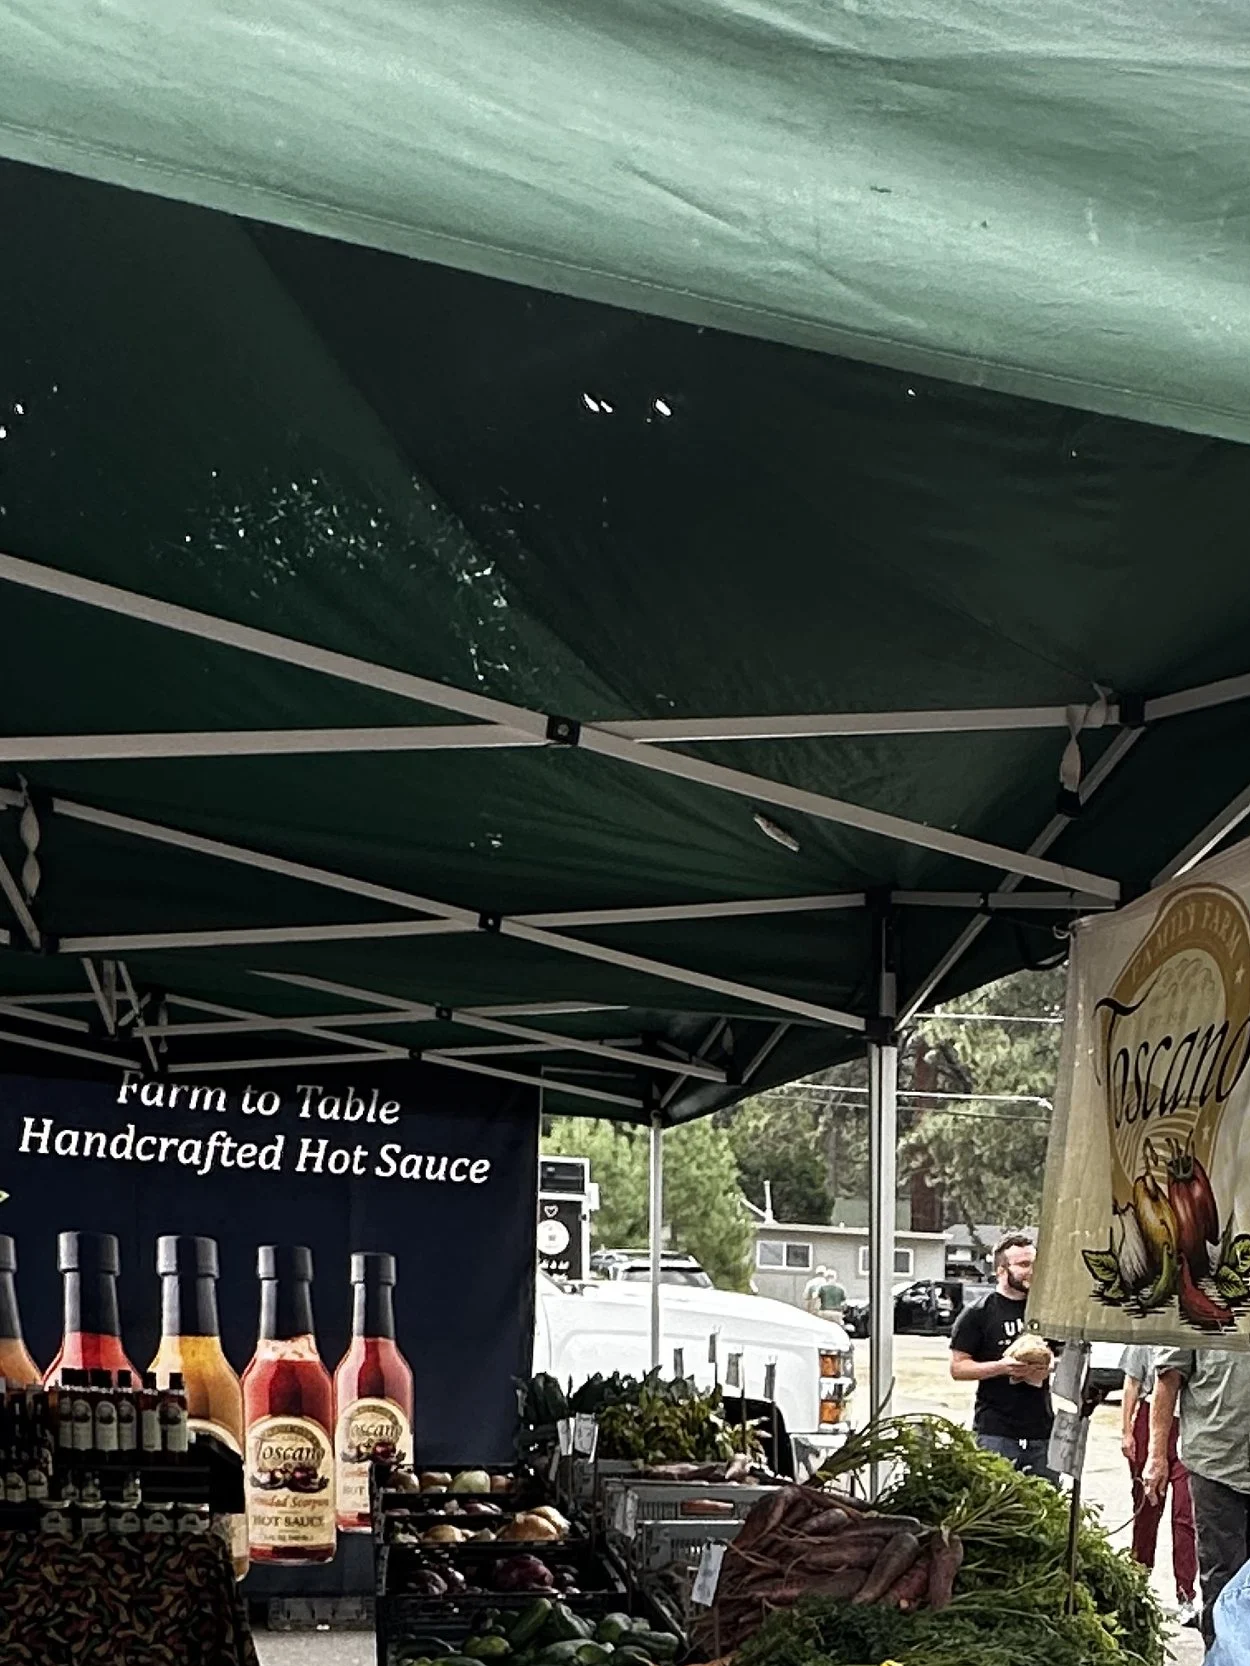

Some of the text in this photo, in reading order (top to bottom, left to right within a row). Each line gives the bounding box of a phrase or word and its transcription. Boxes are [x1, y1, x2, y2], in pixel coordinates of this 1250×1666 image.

[1200, 901, 1243, 958] FARM
[117, 1070, 402, 1125] Farm to Table
[18, 1116, 491, 1184] Handcrafted Hot Sauce
